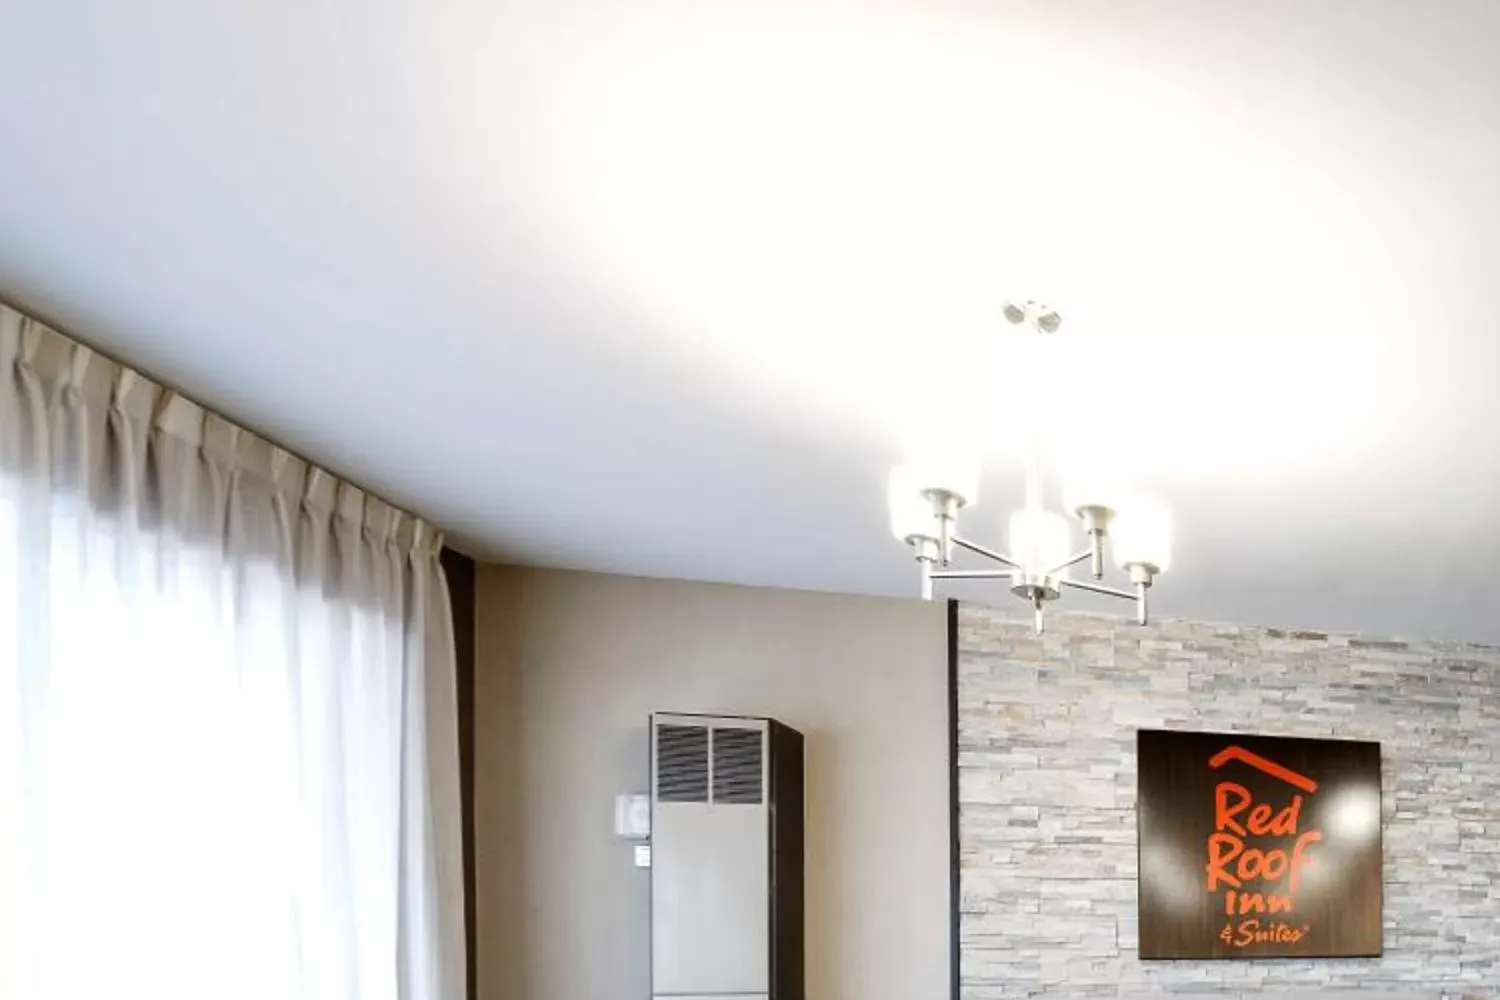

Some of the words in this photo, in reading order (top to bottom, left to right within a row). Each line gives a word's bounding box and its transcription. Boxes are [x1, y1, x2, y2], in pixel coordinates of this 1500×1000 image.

[1215, 782, 1303, 837] Red
[1207, 831, 1322, 894] Roof
[1219, 923, 1233, 945] &
[1234, 919, 1304, 947] Suites
